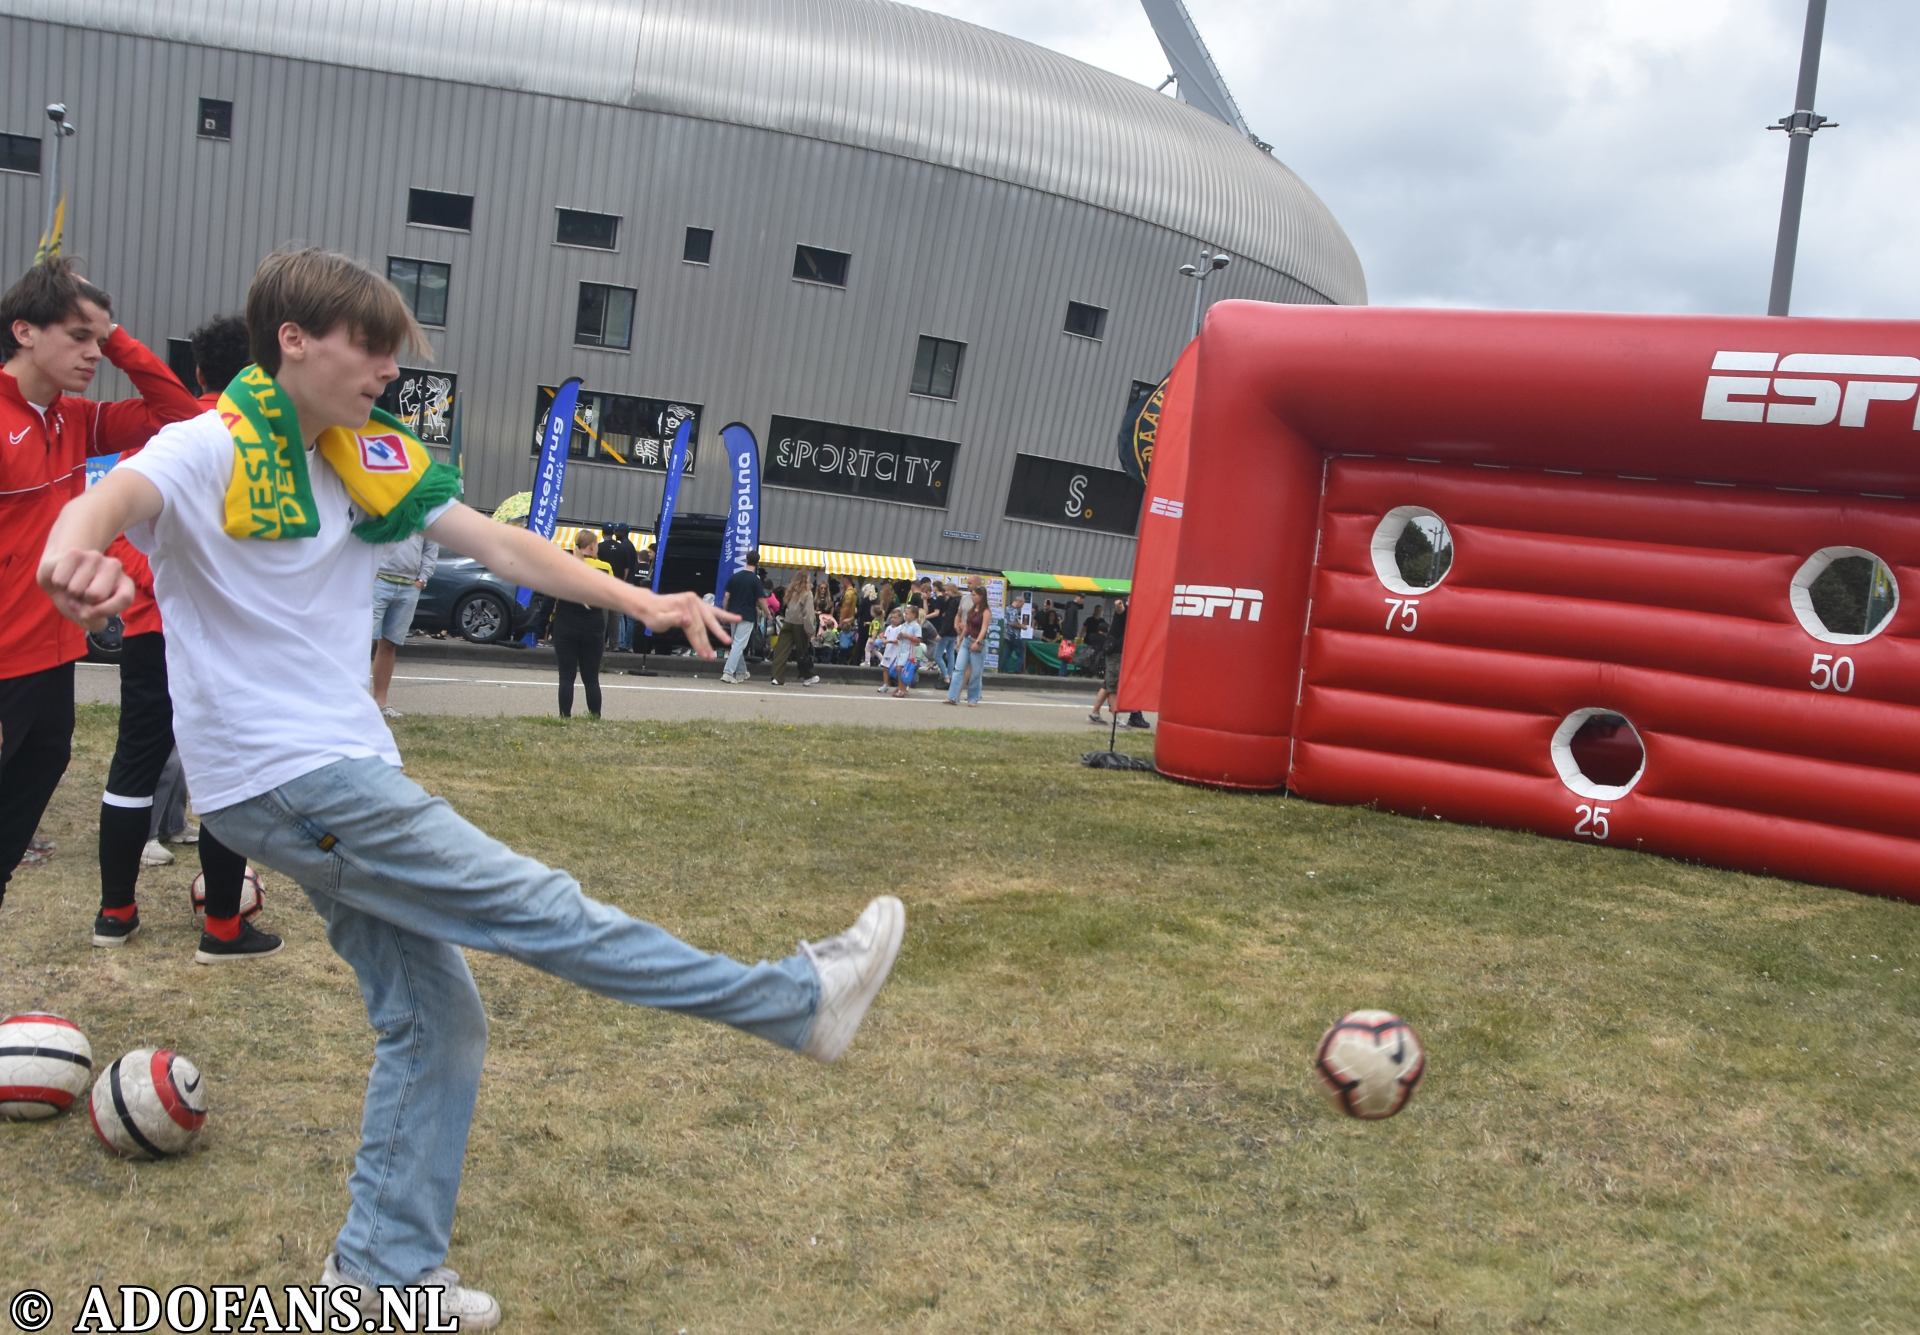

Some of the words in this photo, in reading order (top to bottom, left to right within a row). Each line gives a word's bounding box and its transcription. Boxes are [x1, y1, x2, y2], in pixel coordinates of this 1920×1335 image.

[240, 366, 282, 418] HA
[1701, 350, 1920, 431] ESP
[234, 435, 278, 538] VEST
[269, 433, 307, 524] DEN
[1150, 496, 1184, 519] ES
[1171, 584, 1264, 622] ESPN
[1384, 598, 1419, 633] 75
[1810, 654, 1855, 693] 50
[1574, 804, 1611, 840] 25
